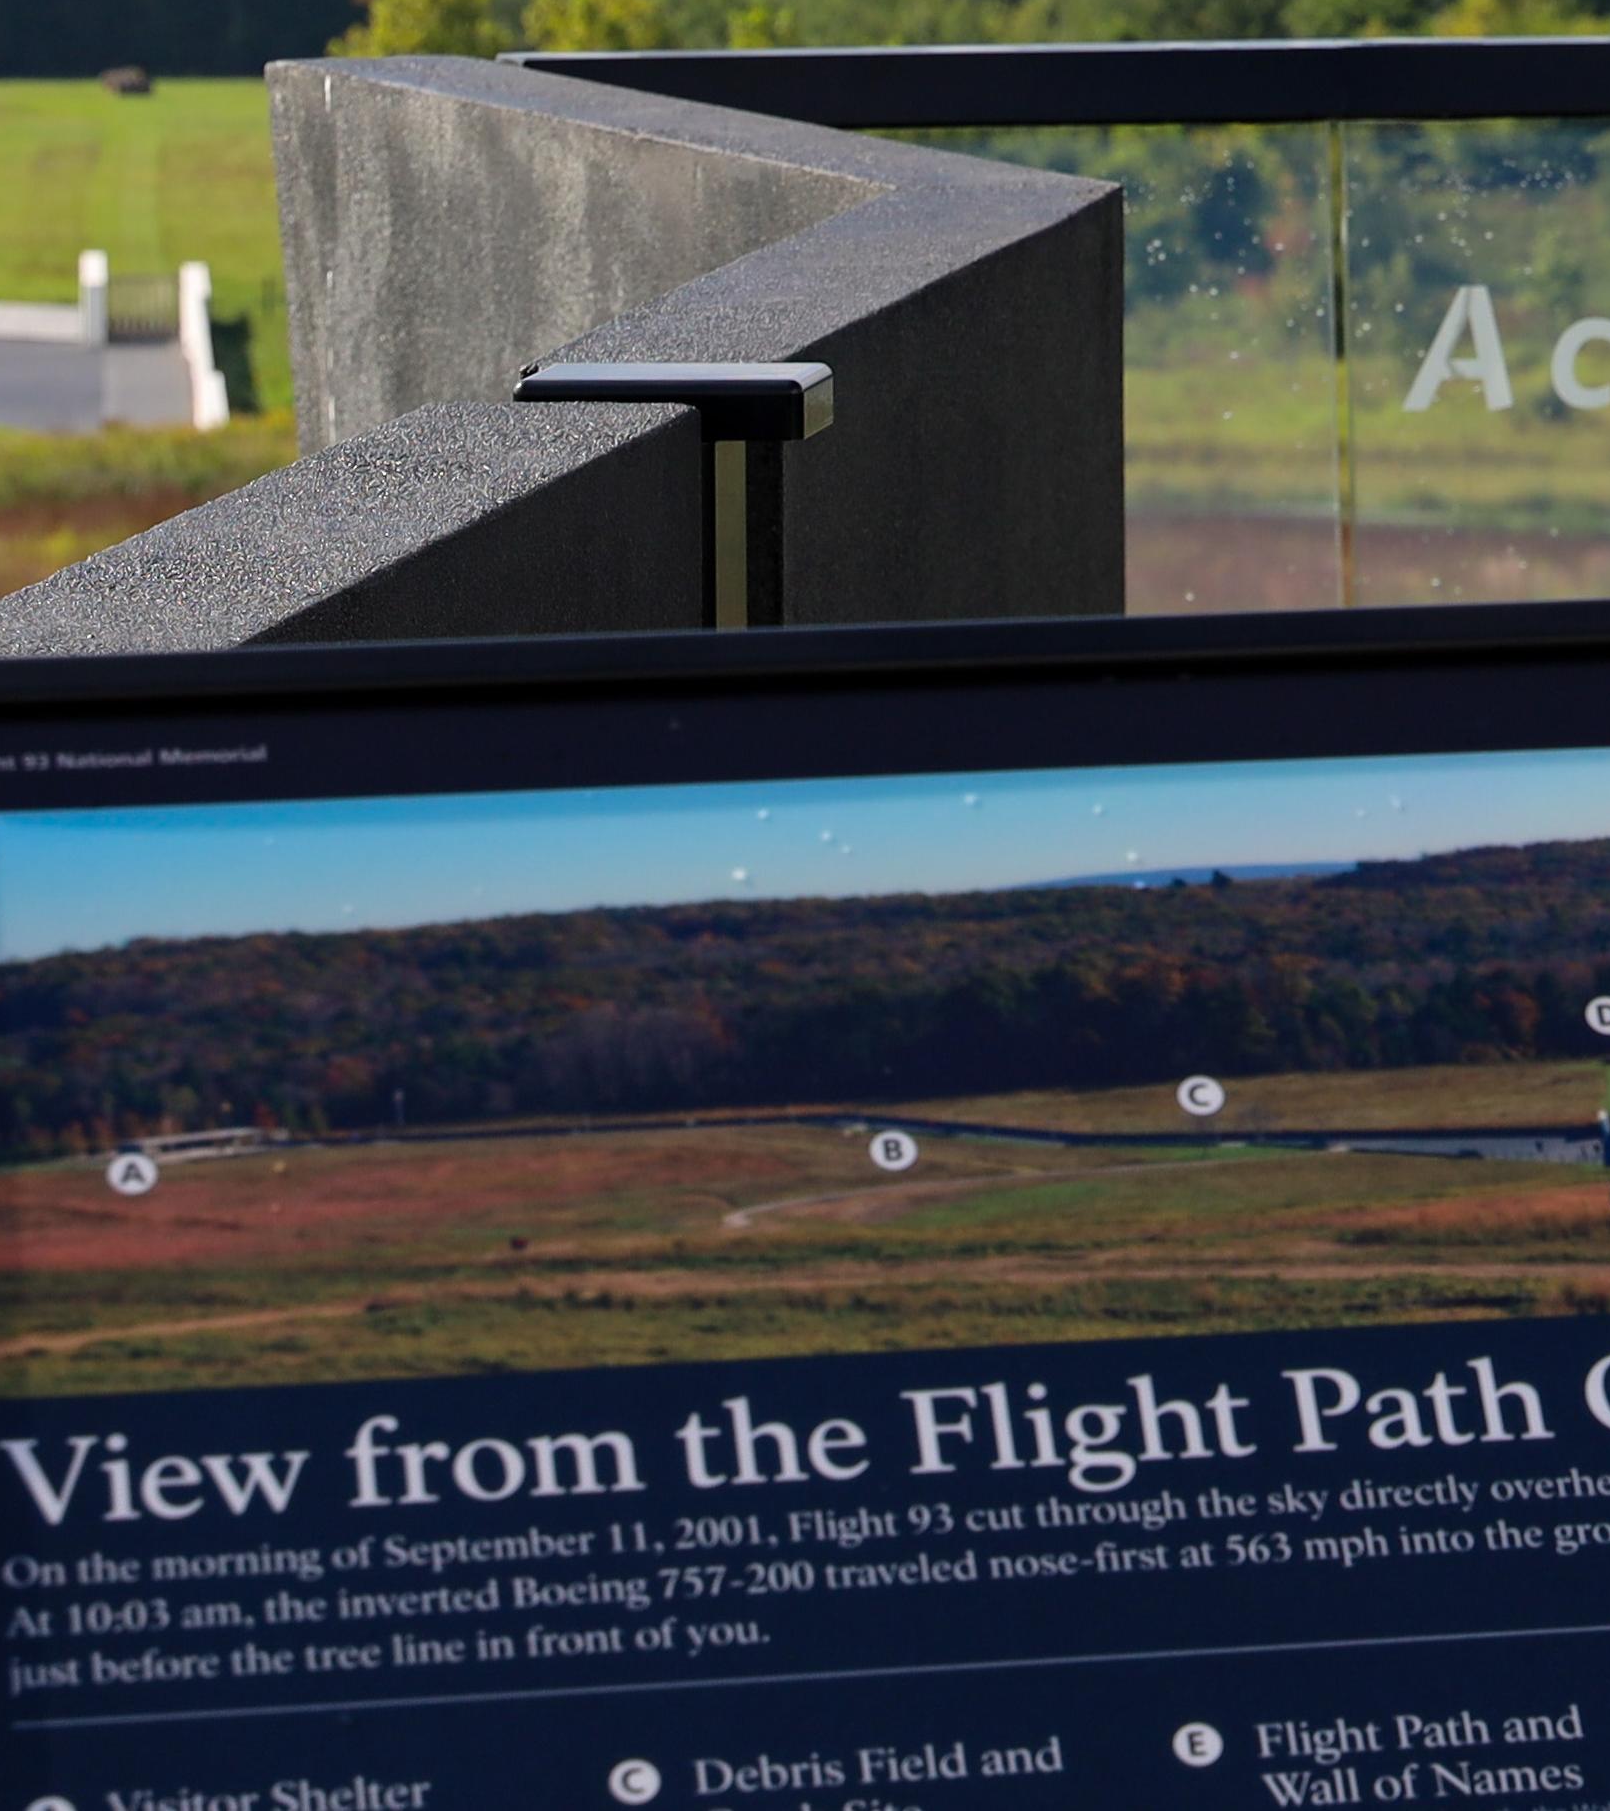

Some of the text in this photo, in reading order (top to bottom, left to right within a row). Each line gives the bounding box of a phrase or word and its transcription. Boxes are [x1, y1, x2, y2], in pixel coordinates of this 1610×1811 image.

[1406, 285, 1511, 411] A
[24, 752, 49, 770] 93
[55, 750, 153, 769] National
[158, 745, 268, 765] Memorial
[1187, 1083, 1209, 1107] C
[120, 1162, 146, 1184] A
[882, 1138, 903, 1162] B
[0, 1432, 310, 1526] View
[345, 1414, 646, 1508] from
[675, 1395, 870, 1489] the
[899, 1373, 1258, 1494] Flight
[1281, 1355, 1556, 1453] Path
[1, 1557, 68, 1588] On
[76, 1550, 141, 1585] the
[151, 1543, 326, 1582] morning
[330, 1535, 375, 1570] of
[382, 1525, 596, 1574] September
[609, 1520, 666, 1554] 11,
[674, 1514, 779, 1551] 2001,
[787, 1506, 898, 1549] Flight
[906, 1501, 955, 1533] 93
[964, 1503, 1025, 1533] cut
[1034, 1489, 1188, 1531] through
[1196, 1486, 1257, 1520] the
[1266, 1482, 1329, 1515] sky
[1338, 1473, 1480, 1513] directly
[8, 1607, 57, 1639] At
[68, 1597, 172, 1635] 10:03
[180, 1598, 254, 1633] am,
[263, 1590, 328, 1625] the
[337, 1577, 501, 1620] inverted
[511, 1573, 652, 1611] Boeing
[657, 1560, 816, 1600] 757-200
[823, 1548, 979, 1590] traveled
[988, 1540, 1170, 1580] nose-first
[1180, 1538, 1216, 1566] at
[1225, 1531, 1293, 1565] 563
[1303, 1525, 1390, 1569] mph
[1399, 1525, 1476, 1556] into
[1483, 1518, 1544, 1552] the
[10, 1615, 771, 1695] just before the tree line in front of you.
[1187, 1731, 1205, 1757] E
[1255, 1702, 1585, 1766] Flight Path and
[619, 1766, 644, 1796] C
[694, 1734, 1064, 1796] Debris Field and
[1261, 1760, 1585, 1808] Wall of Names
[107, 1788, 260, 1811] Visitor
[270, 1774, 432, 1811] Shelter
